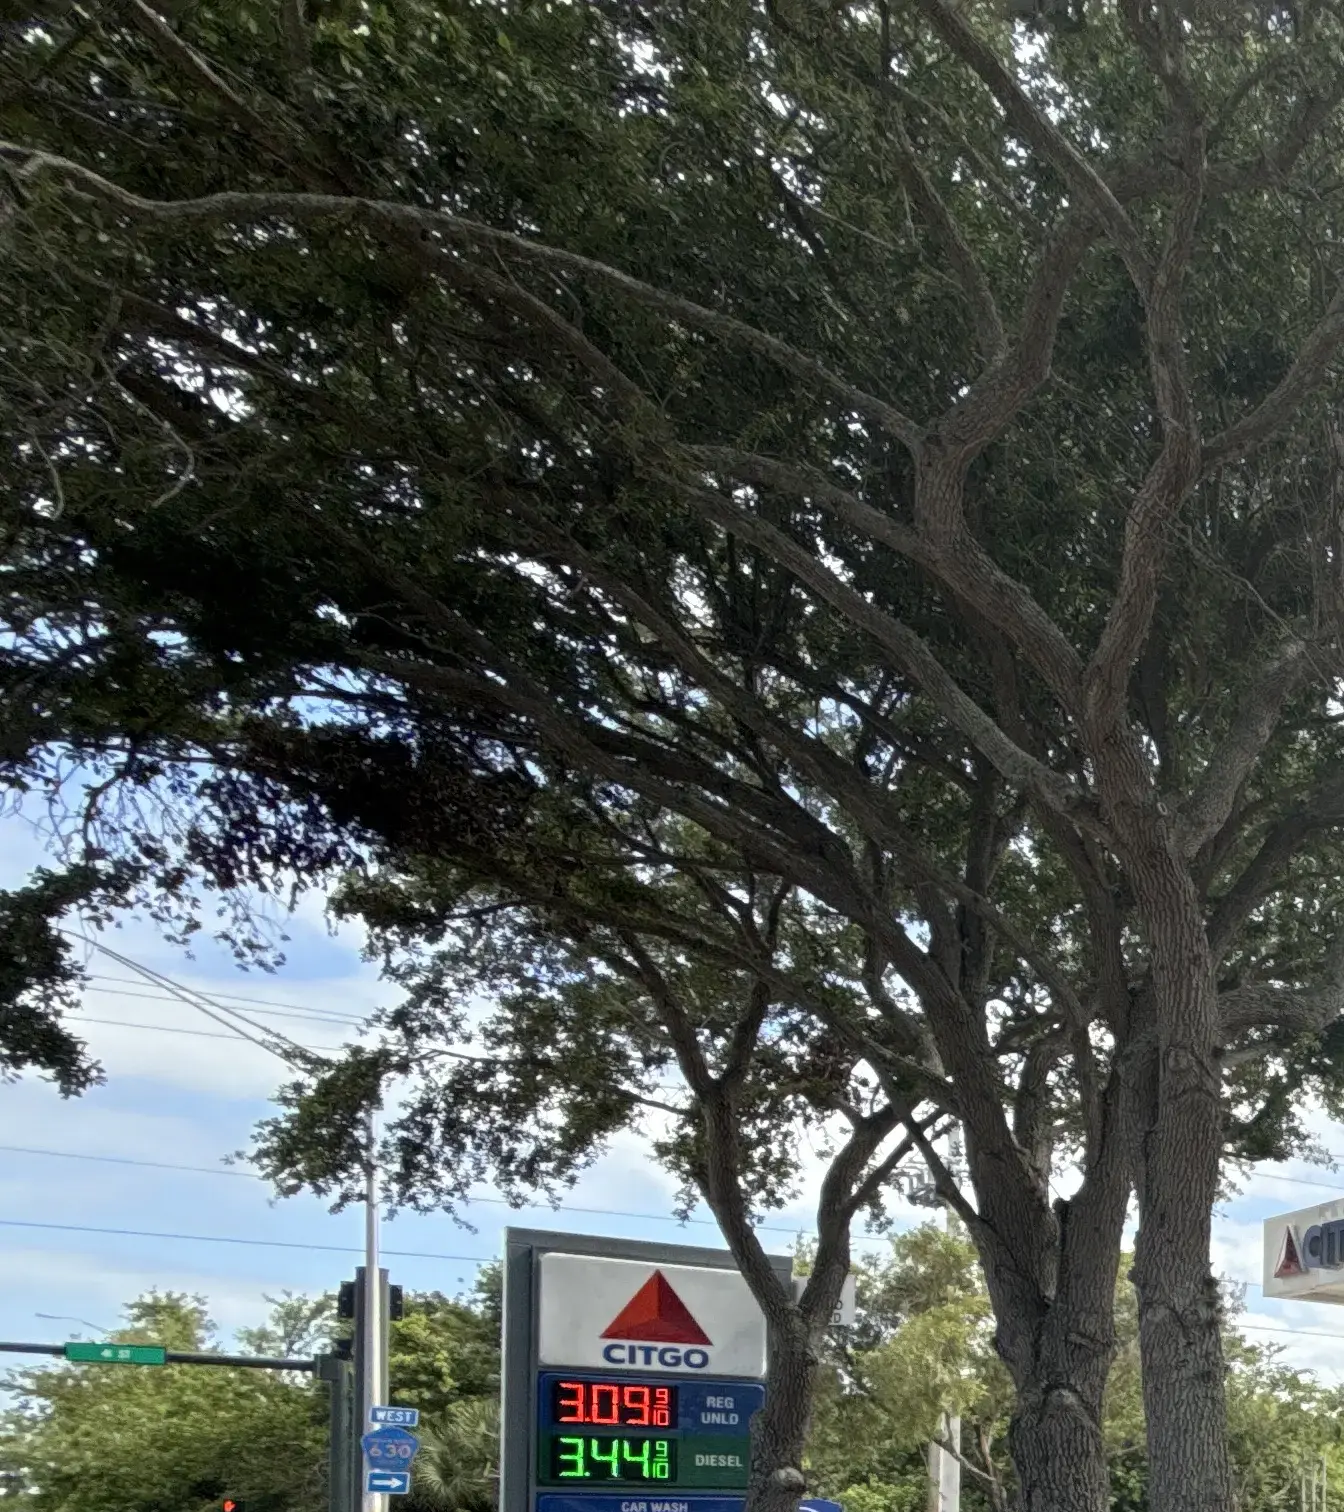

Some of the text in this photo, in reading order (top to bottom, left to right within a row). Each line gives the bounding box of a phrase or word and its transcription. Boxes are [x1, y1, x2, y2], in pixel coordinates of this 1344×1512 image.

[602, 1344, 709, 1368] CITGO
[559, 1382, 650, 1426] 3.09
[706, 1396, 734, 1409] REG
[376, 1411, 412, 1423] WEST
[702, 1411, 739, 1425] UNLD
[369, 1442, 411, 1458] 630
[559, 1437, 650, 1478] 3.44
[695, 1454, 743, 1468] DIESEL
[621, 1502, 688, 1512] CAR WASH
